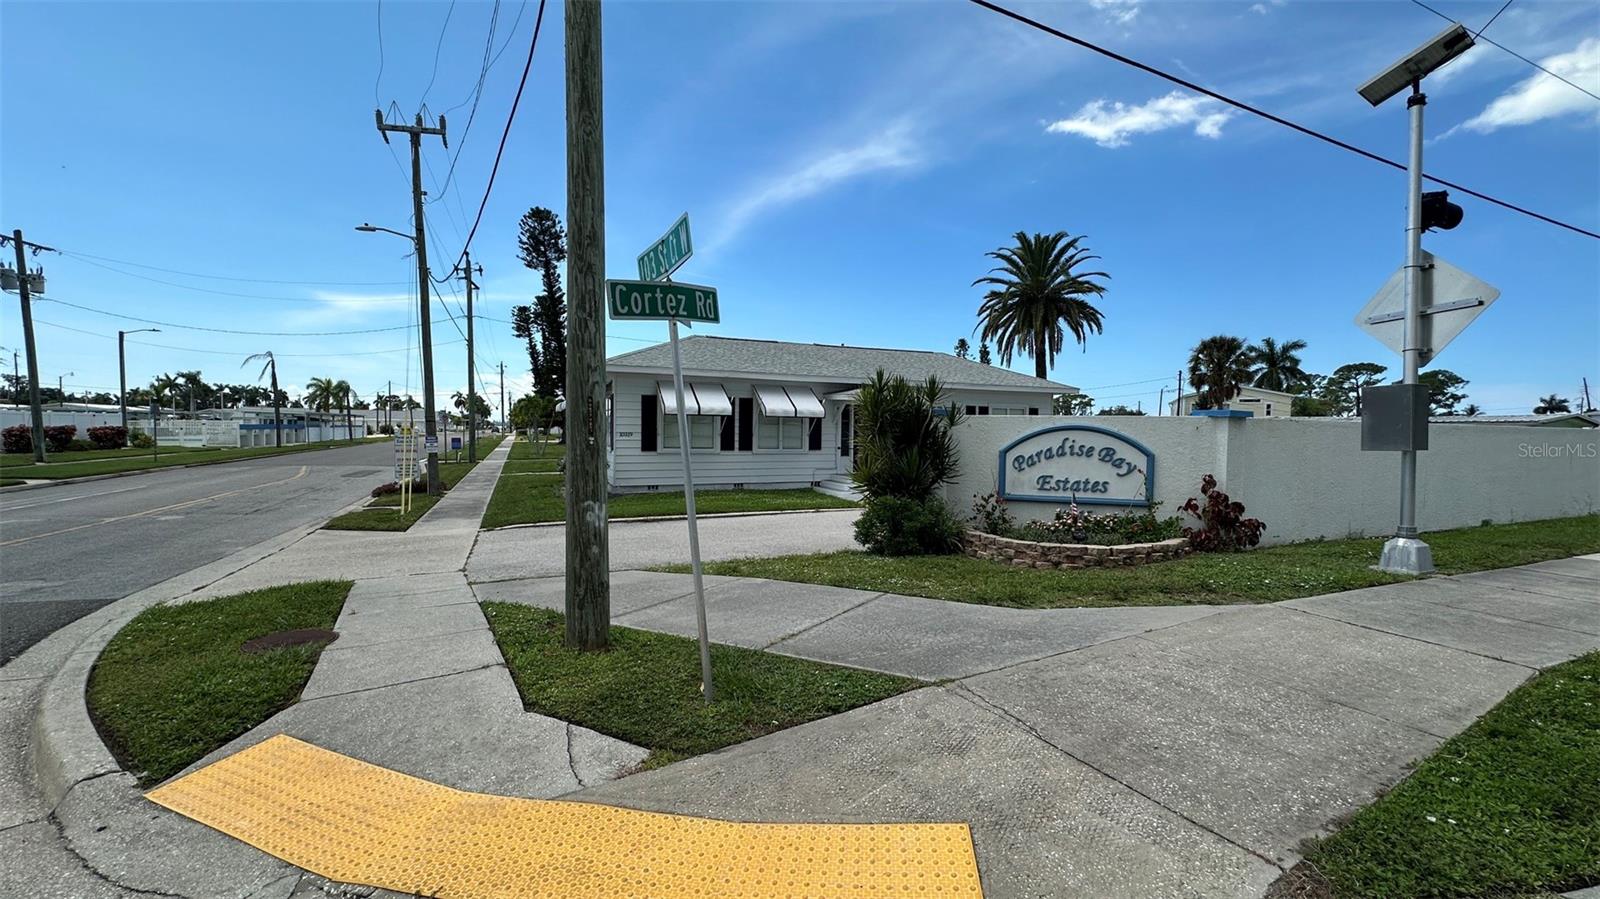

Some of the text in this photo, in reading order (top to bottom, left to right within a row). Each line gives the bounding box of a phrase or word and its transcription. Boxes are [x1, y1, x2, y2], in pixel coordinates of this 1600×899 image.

[640, 251, 656, 281] 103
[658, 244, 669, 272] St
[679, 220, 688, 254] W
[615, 284, 714, 318] Cortez Rd
[1012, 437, 1137, 477] Paradise Bay
[1036, 474, 1110, 493] Estates
